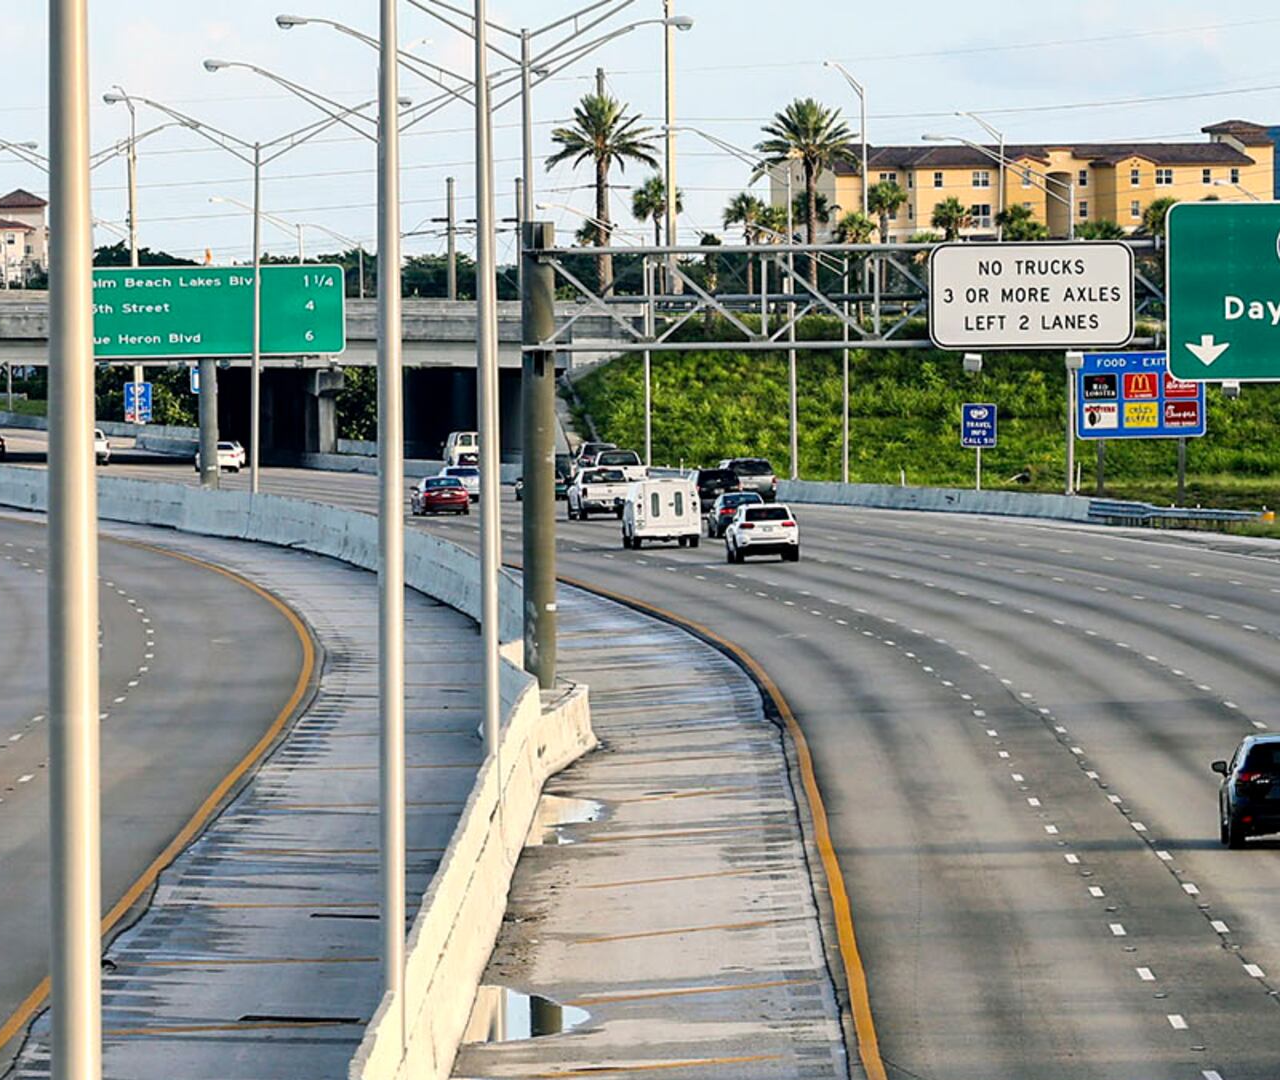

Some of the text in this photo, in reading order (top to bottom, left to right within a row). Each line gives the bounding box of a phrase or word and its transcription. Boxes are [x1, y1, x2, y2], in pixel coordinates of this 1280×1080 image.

[978, 259, 1085, 276] NO TRUCKS
[92, 278, 117, 288] alm
[124, 277, 172, 288] Beach
[179, 276, 222, 287] Lakes
[229, 276, 260, 286] Blv
[943, 287, 1121, 303] 3 OR MORE AXLES
[92, 300, 315, 314] 5th Street 4
[965, 314, 1099, 331] LEFT 2 LANES
[93, 330, 314, 345] ue Heron Blvd 6
[1096, 358, 1127, 368] FOOD
